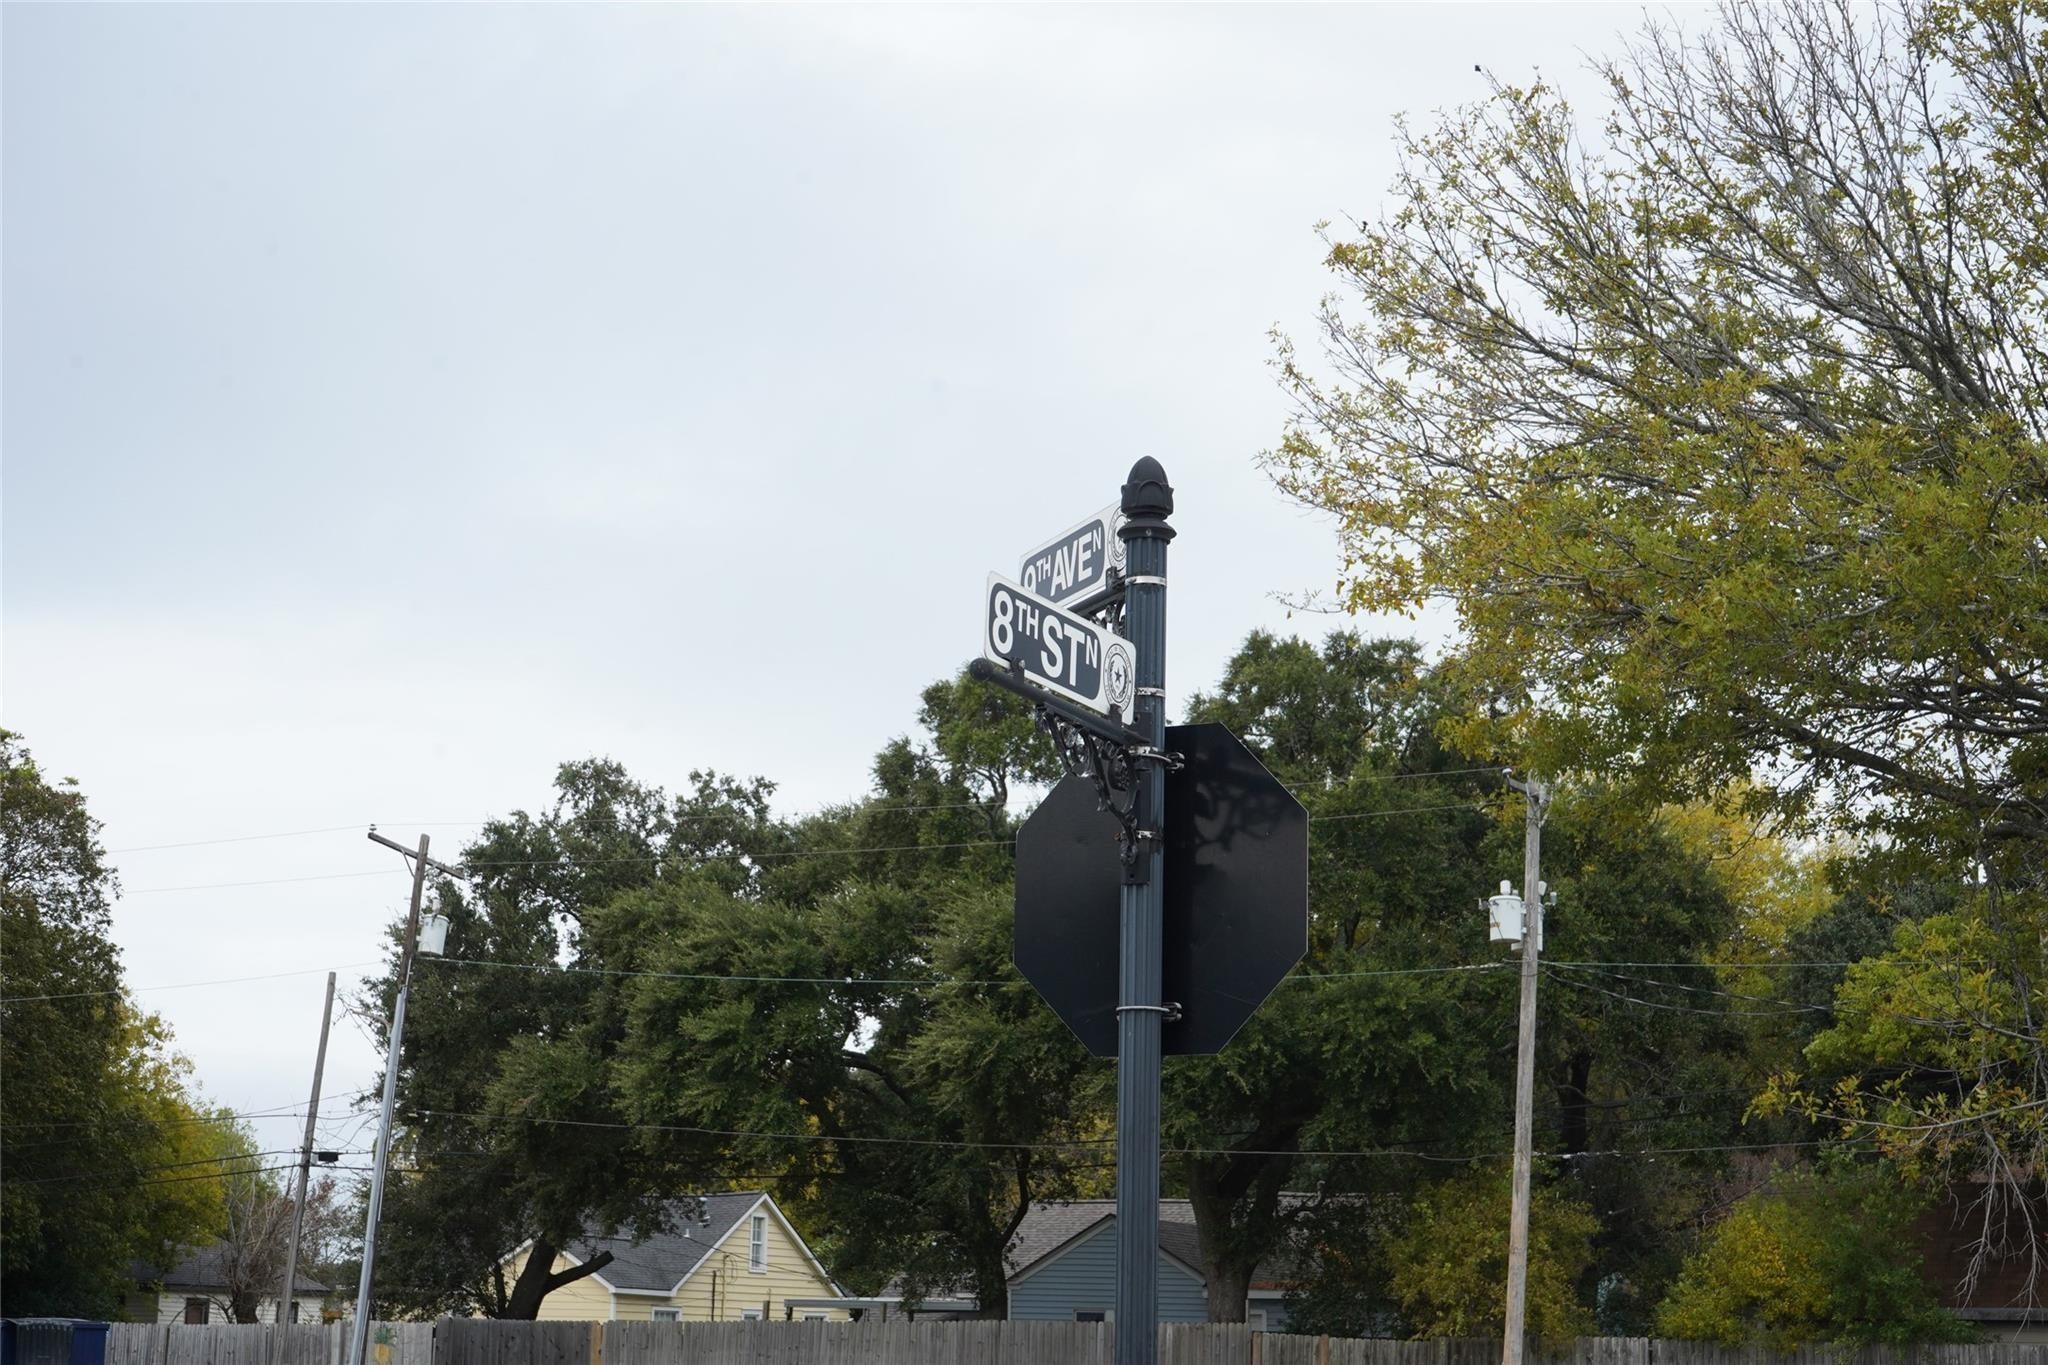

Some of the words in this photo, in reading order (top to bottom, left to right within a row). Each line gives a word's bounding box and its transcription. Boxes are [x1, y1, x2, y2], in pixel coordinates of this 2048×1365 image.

[1050, 532, 1092, 597] AVE
[1093, 527, 1102, 553] N
[993, 590, 1039, 654] 8TH
[1040, 615, 1085, 687] ST
[1085, 635, 1098, 669] N
